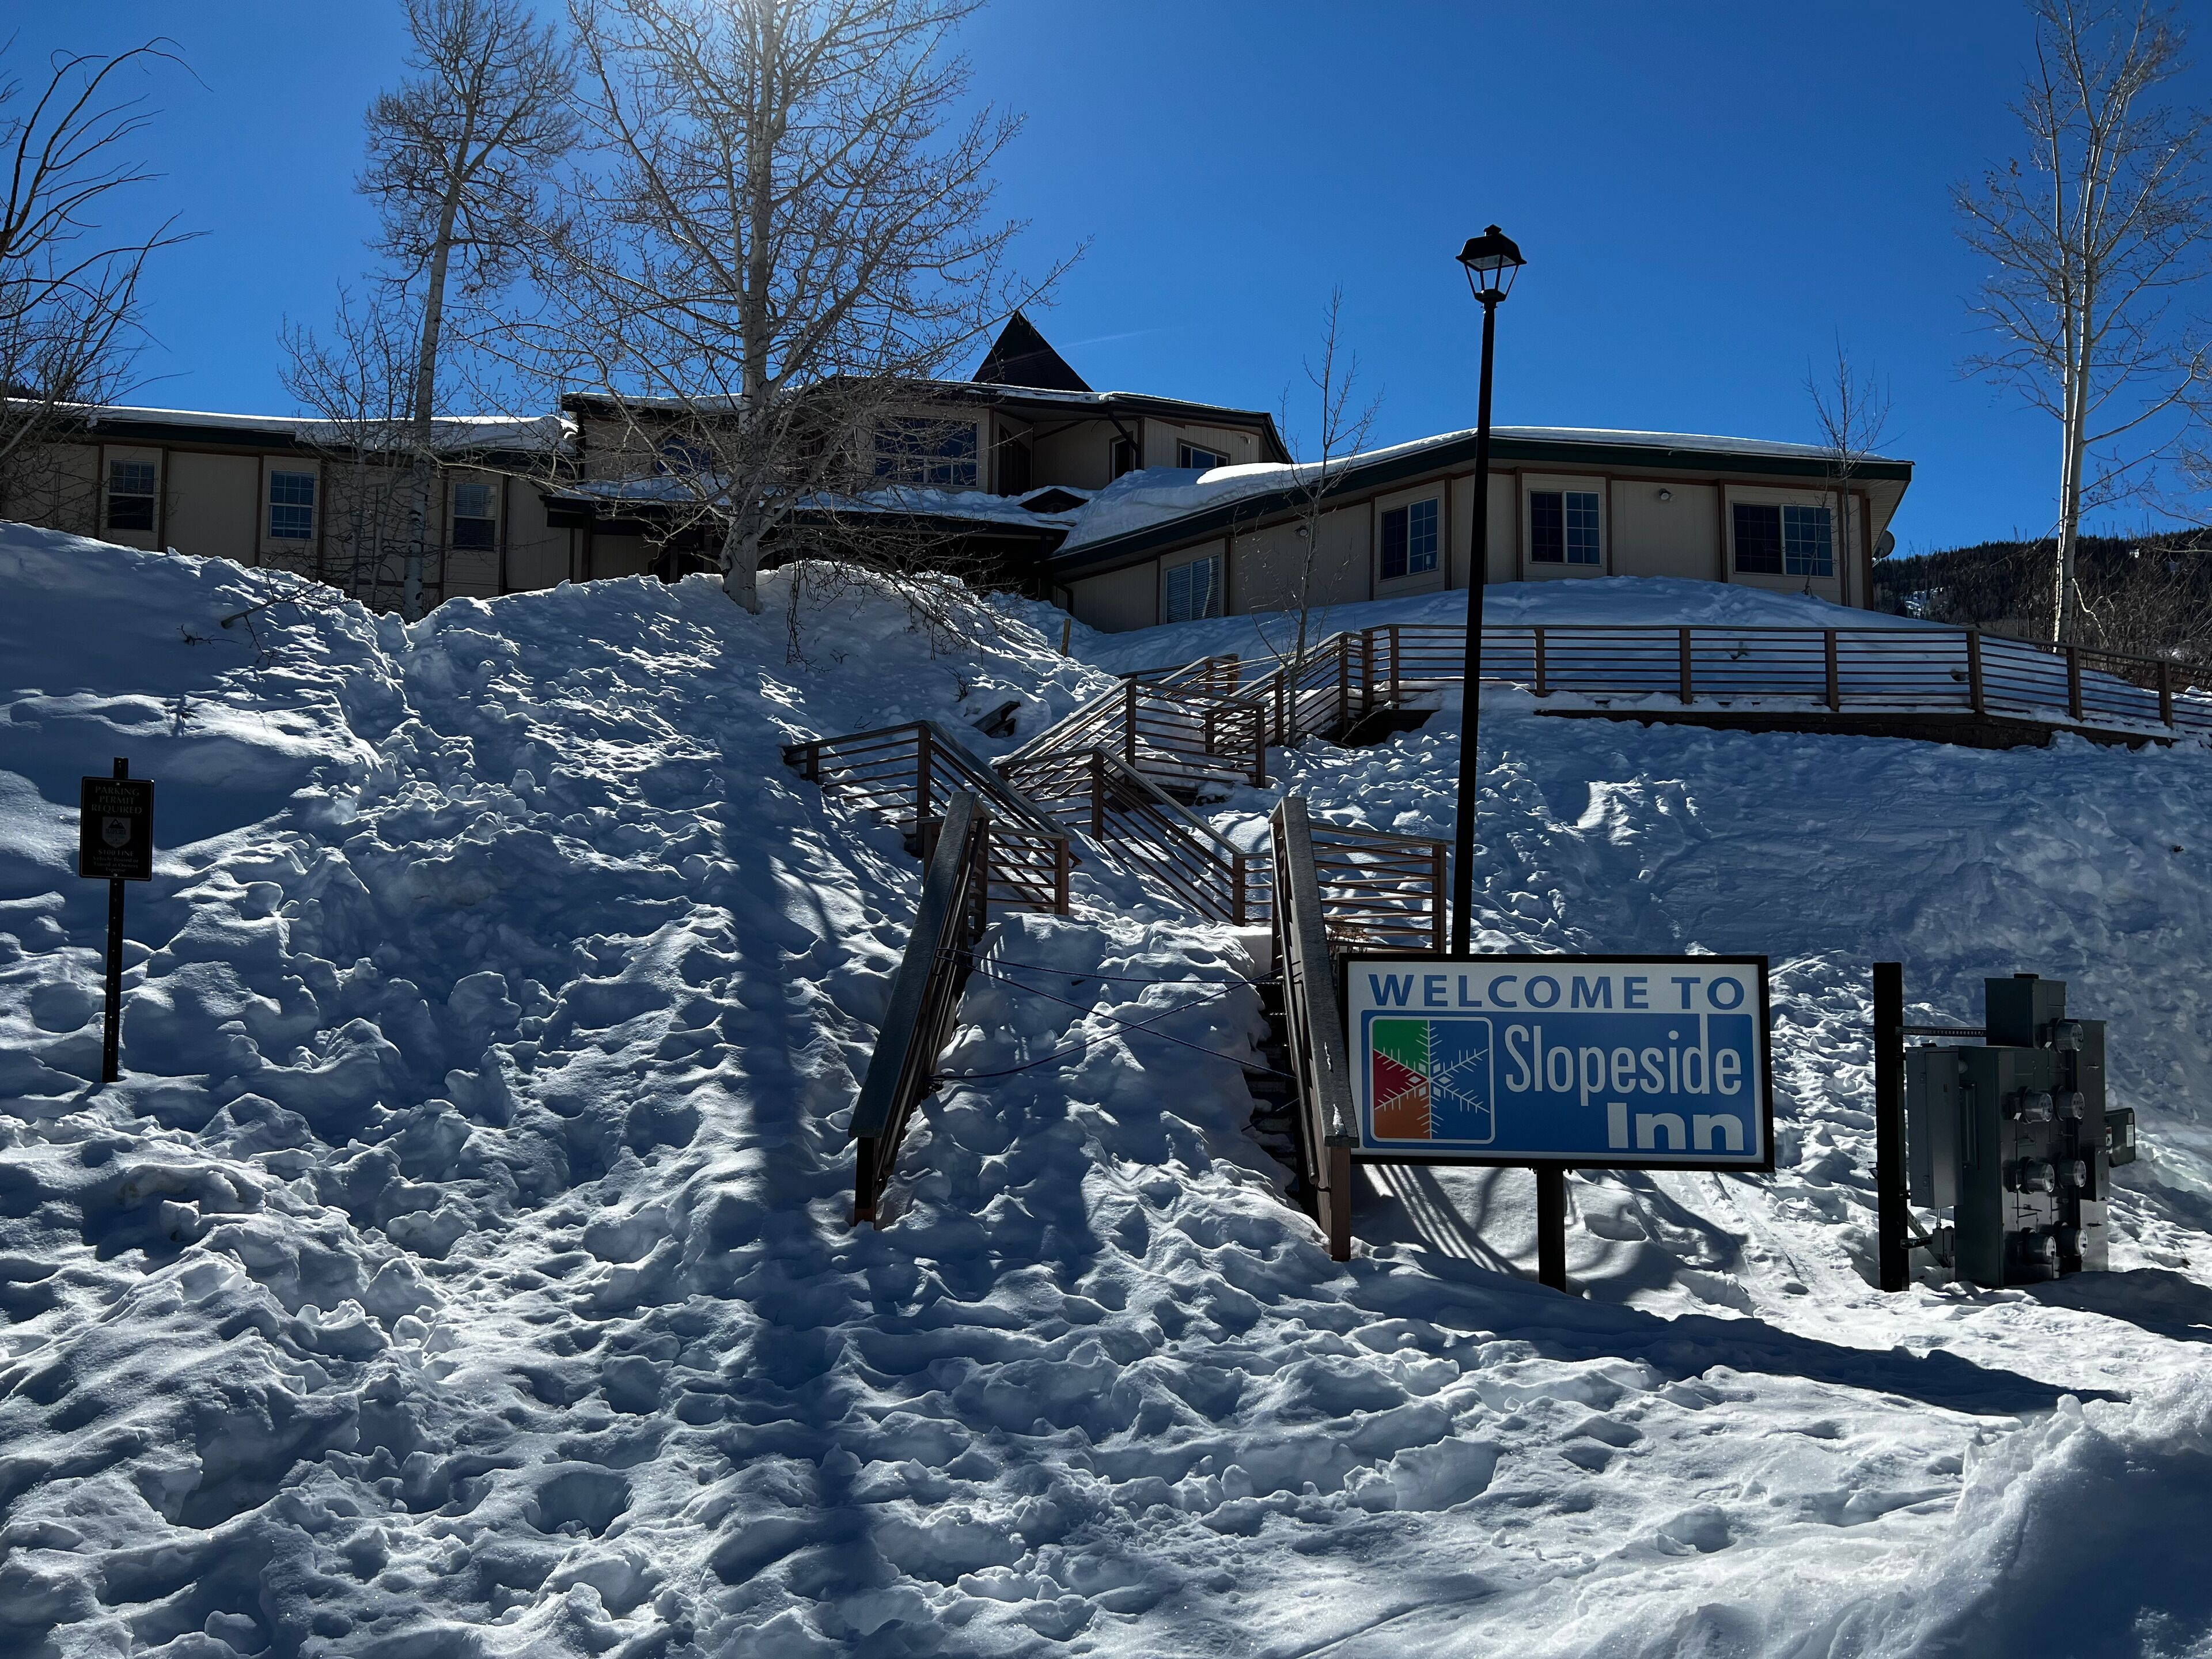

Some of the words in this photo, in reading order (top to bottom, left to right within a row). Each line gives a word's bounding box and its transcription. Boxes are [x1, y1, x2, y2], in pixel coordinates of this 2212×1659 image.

[95, 786, 140, 796] PARKING
[99, 795, 134, 805] PERMIT
[92, 804, 142, 814] REQUIRED
[1368, 974, 1649, 1009] WELCOME
[1671, 976, 1745, 1010] TO
[1504, 1013, 1742, 1107] Slopeside
[1607, 1102, 1744, 1151] Inn
